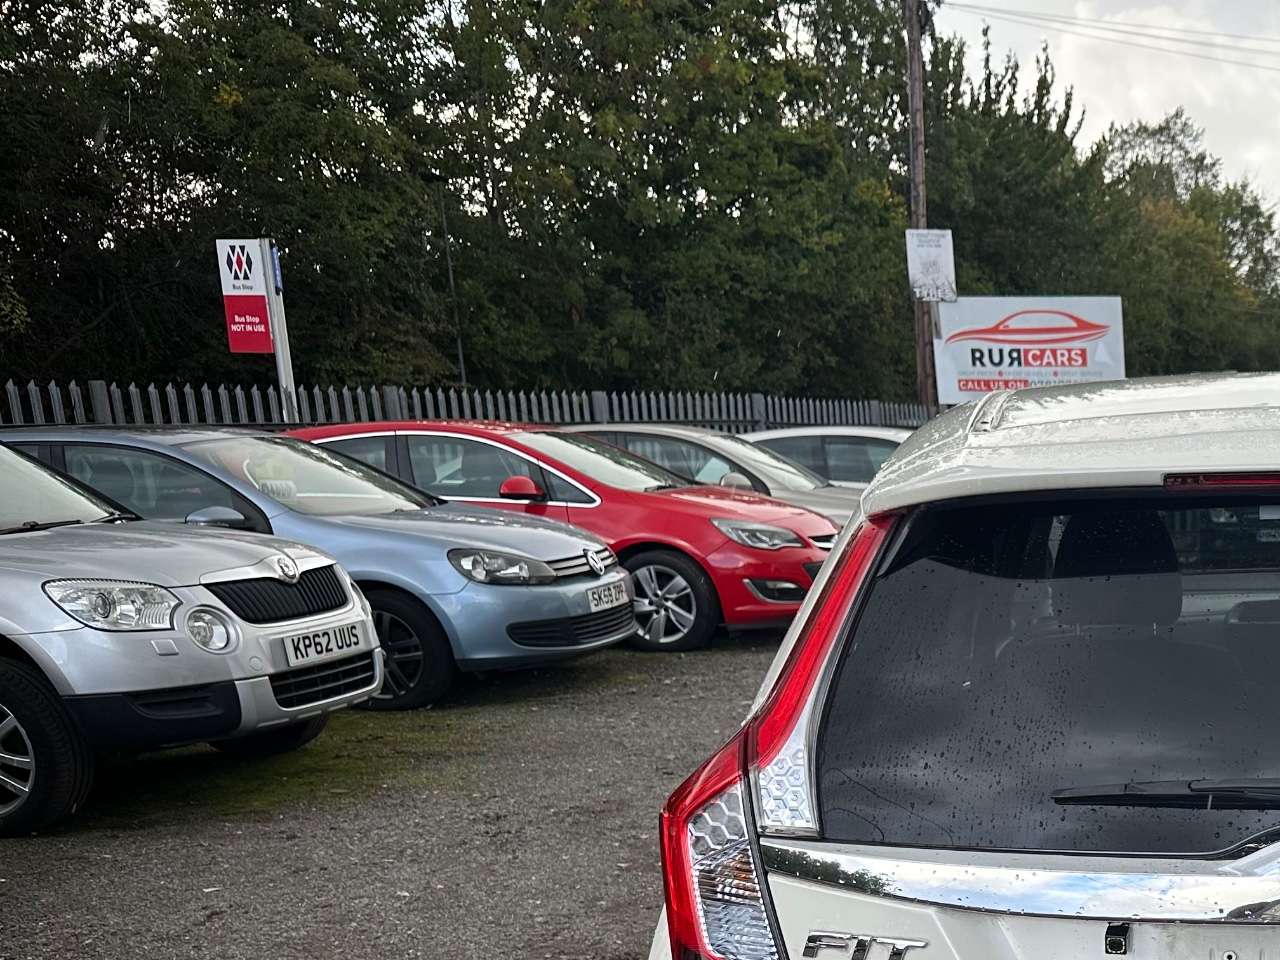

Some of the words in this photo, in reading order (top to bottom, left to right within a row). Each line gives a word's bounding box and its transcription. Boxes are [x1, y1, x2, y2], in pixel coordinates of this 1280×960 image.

[234, 314, 245, 323] Bus
[246, 315, 260, 324] Stop
[231, 324, 245, 332] NOT
[246, 324, 253, 332] IN
[254, 324, 266, 332] USE
[960, 381, 987, 390] CALL
[990, 381, 1006, 390] US
[1008, 382, 1025, 390] ON
[291, 631, 333, 660] KP62
[334, 625, 359, 650] UUS
